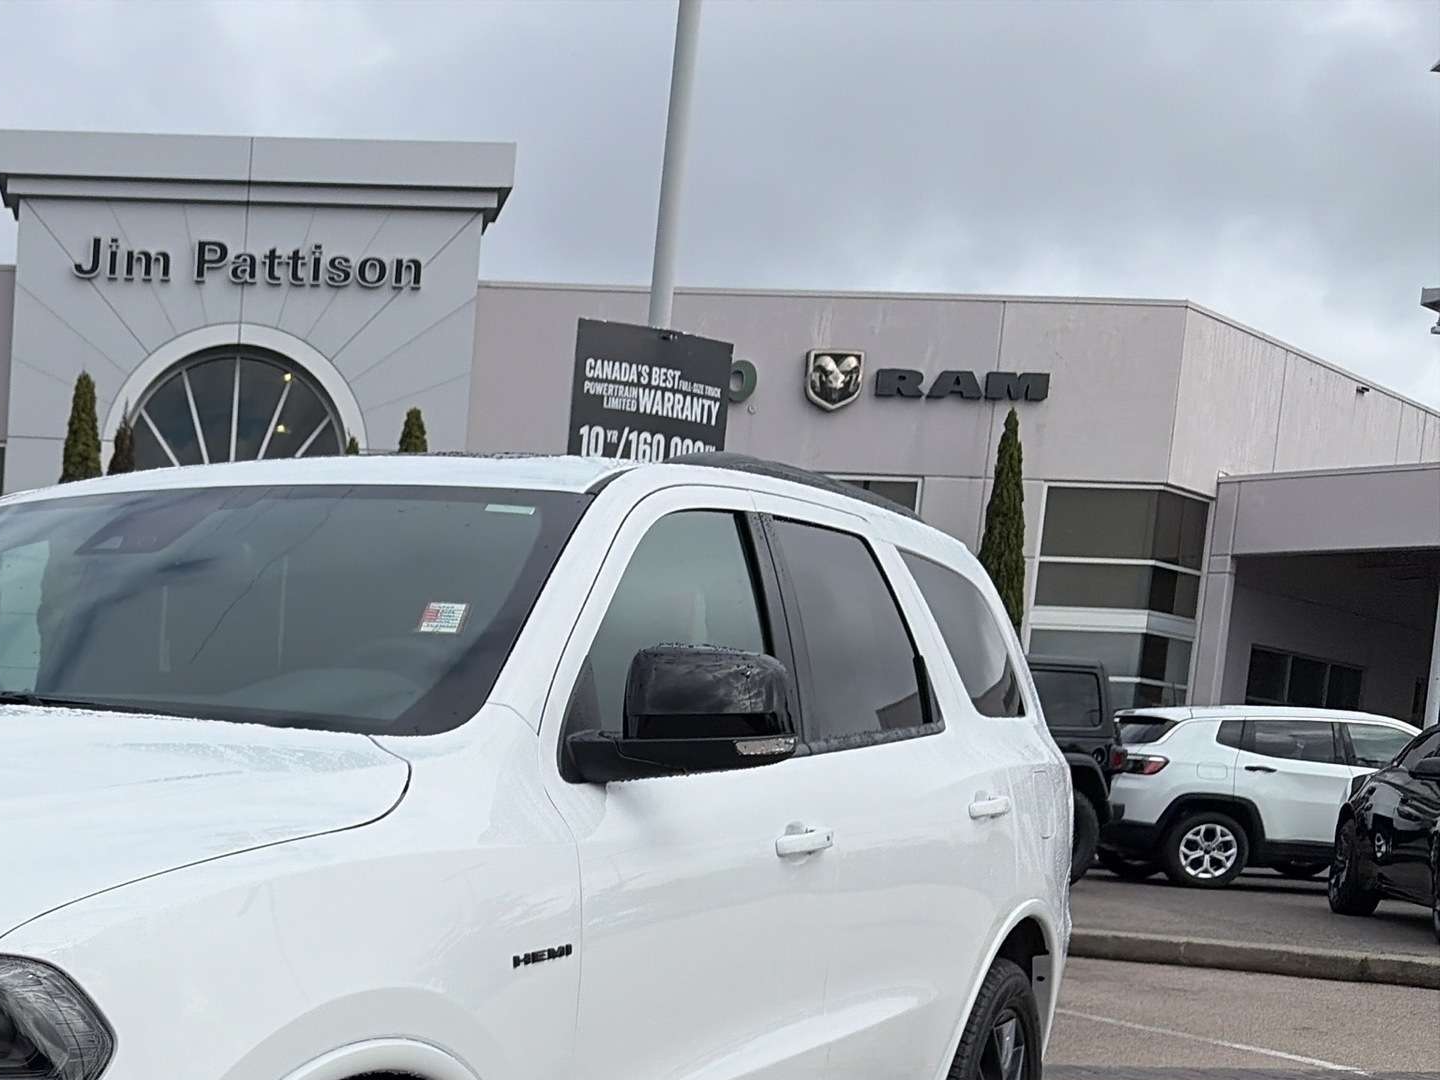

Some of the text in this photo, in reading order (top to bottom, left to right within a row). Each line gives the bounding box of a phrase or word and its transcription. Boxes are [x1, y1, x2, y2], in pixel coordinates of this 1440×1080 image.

[73, 236, 424, 290] Jim Pattison
[583, 380, 638, 400] POWERTRAIN
[585, 358, 650, 385] CANADA'S
[650, 366, 681, 390] BEST
[704, 385, 722, 399] TRUCK
[874, 368, 1052, 402] RAM
[602, 395, 638, 413] LIMITED
[638, 387, 721, 426] WARRANTY
[513, 944, 572, 969] HEMI
